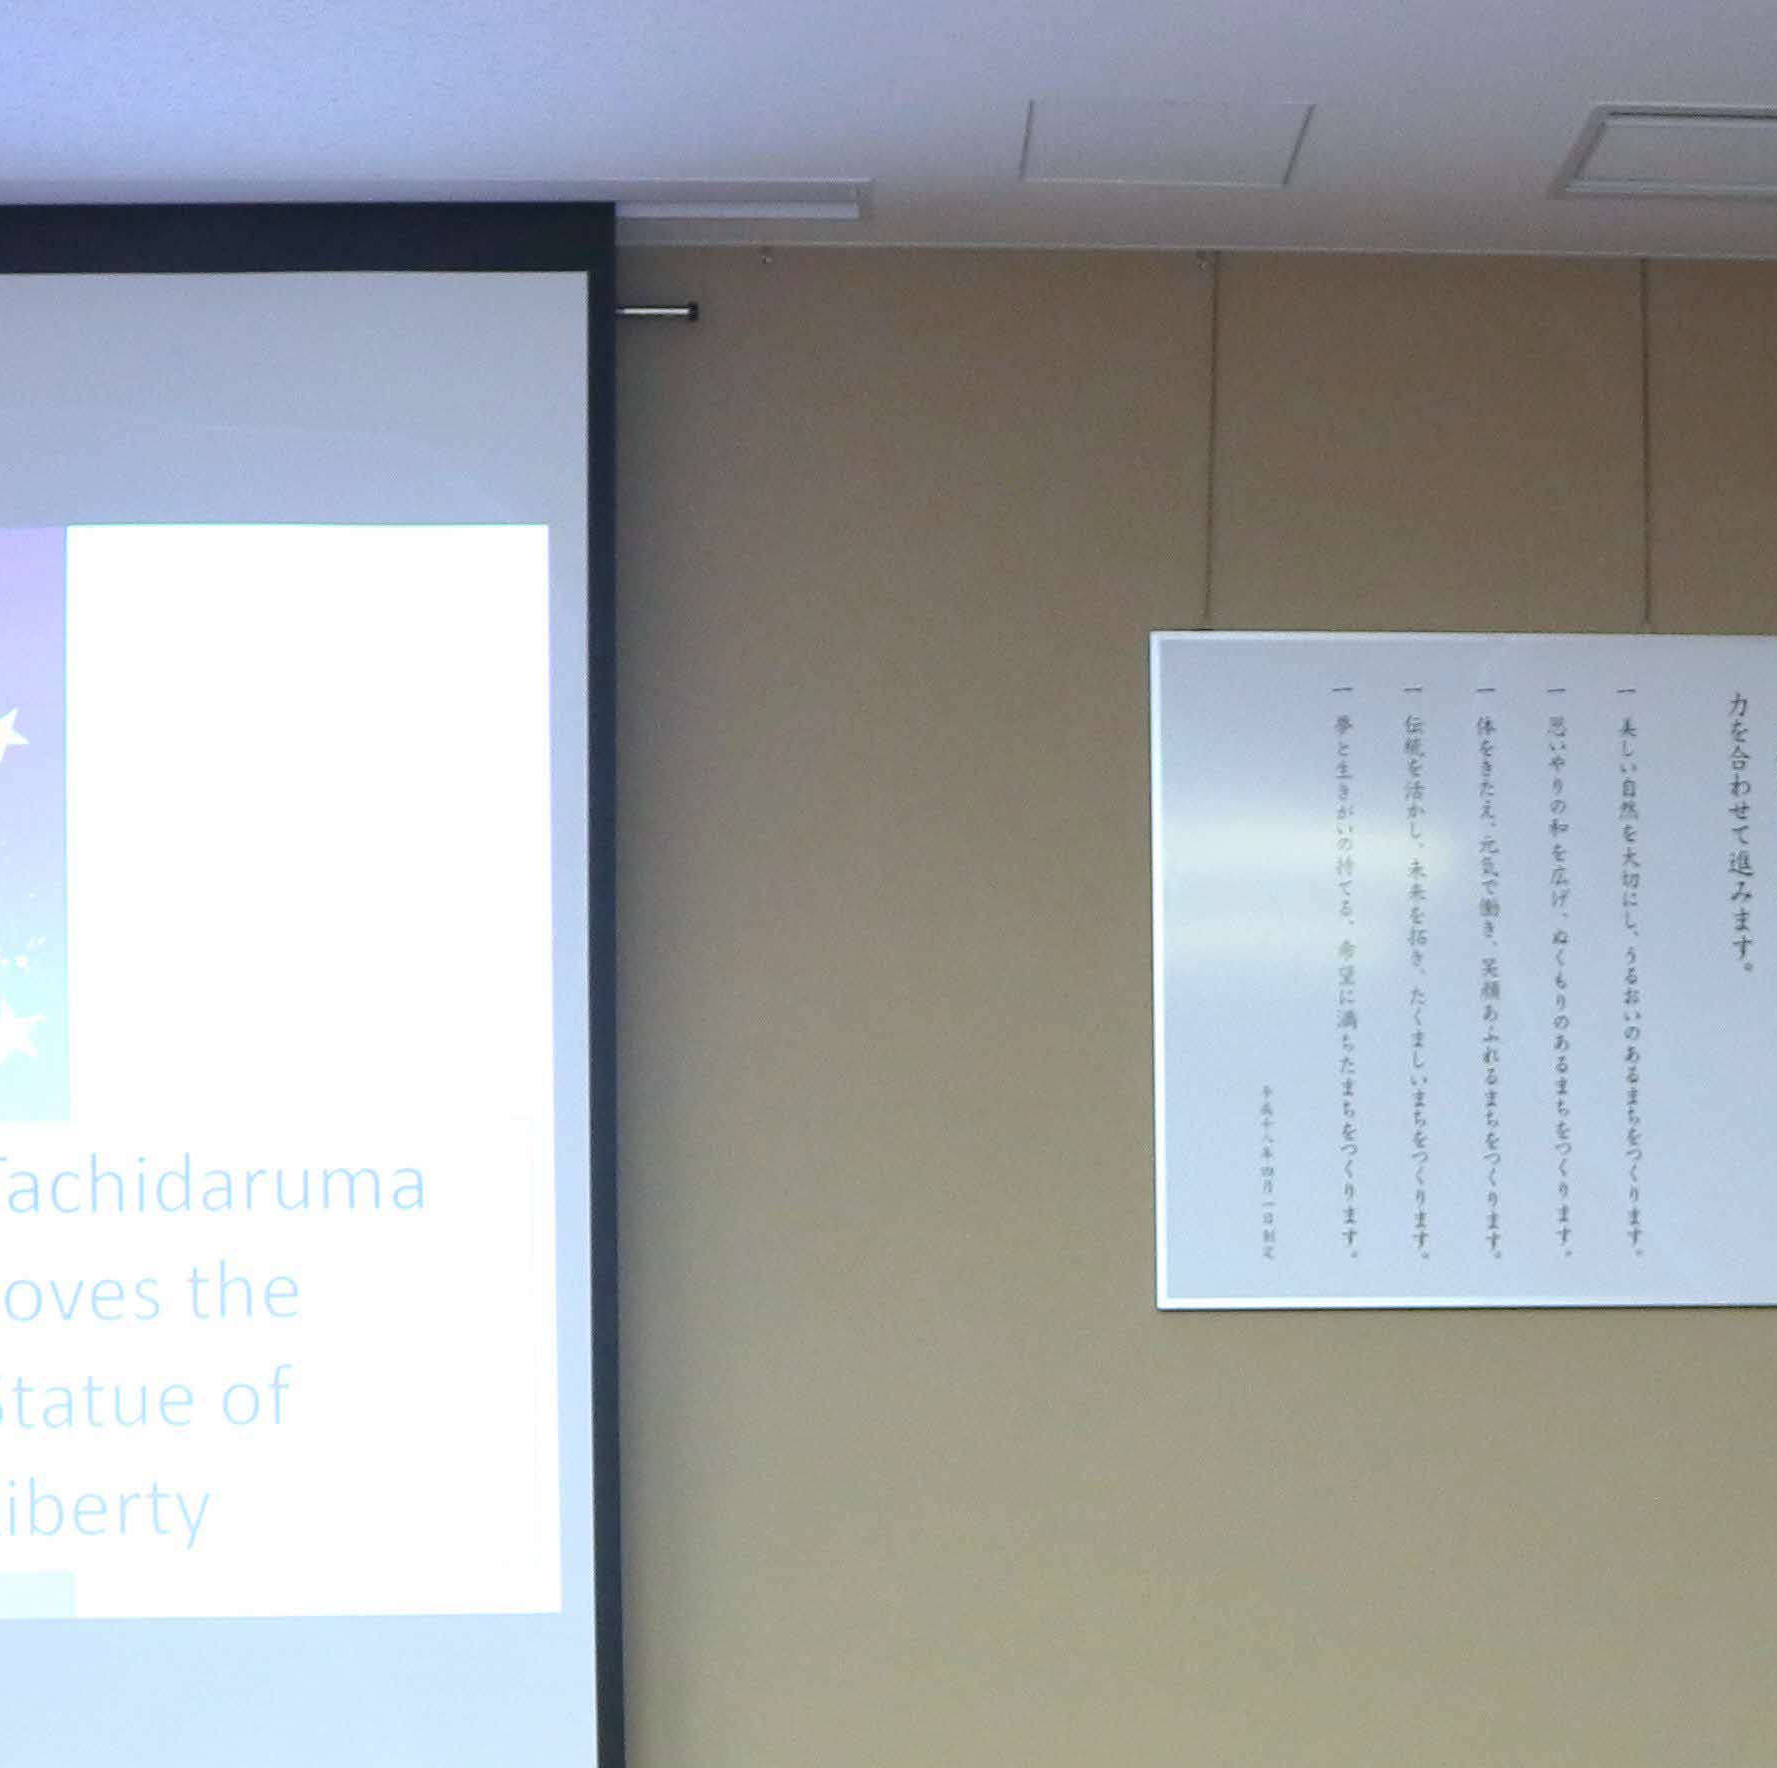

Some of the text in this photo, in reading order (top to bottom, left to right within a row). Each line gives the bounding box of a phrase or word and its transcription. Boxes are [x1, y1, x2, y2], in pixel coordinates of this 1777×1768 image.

[1728, 691, 1755, 972] 力を合わせて進みます。
[189, 1259, 299, 1320] the
[223, 1364, 292, 1425] of
